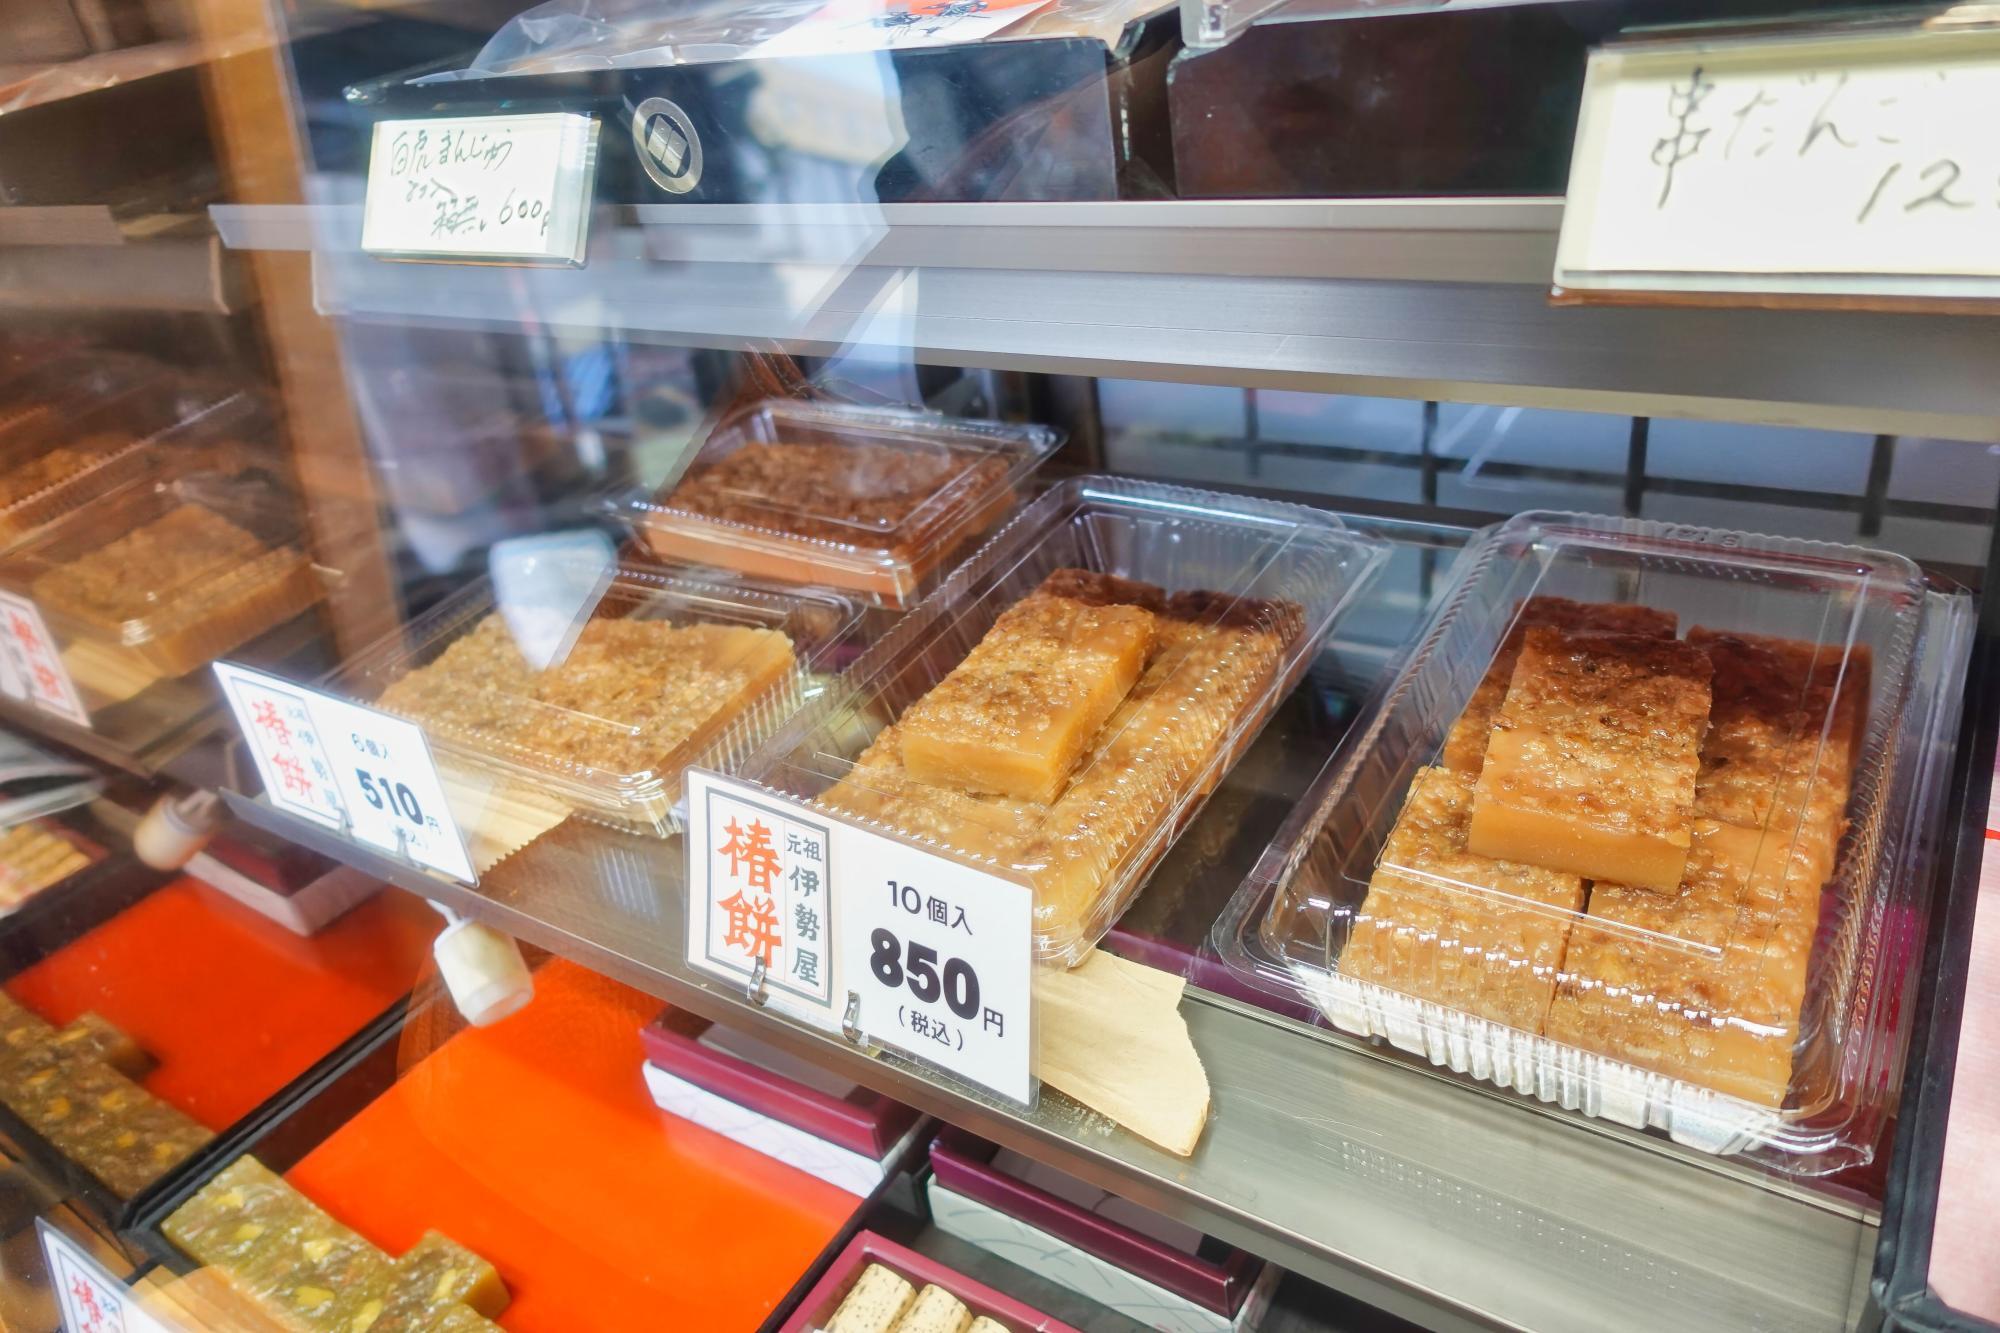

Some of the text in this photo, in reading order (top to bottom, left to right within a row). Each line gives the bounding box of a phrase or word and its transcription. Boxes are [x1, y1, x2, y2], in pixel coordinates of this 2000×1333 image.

[1857, 158, 2000, 224] 12
[717, 815, 783, 968] 椿餅
[887, 880, 973, 936] 10個入
